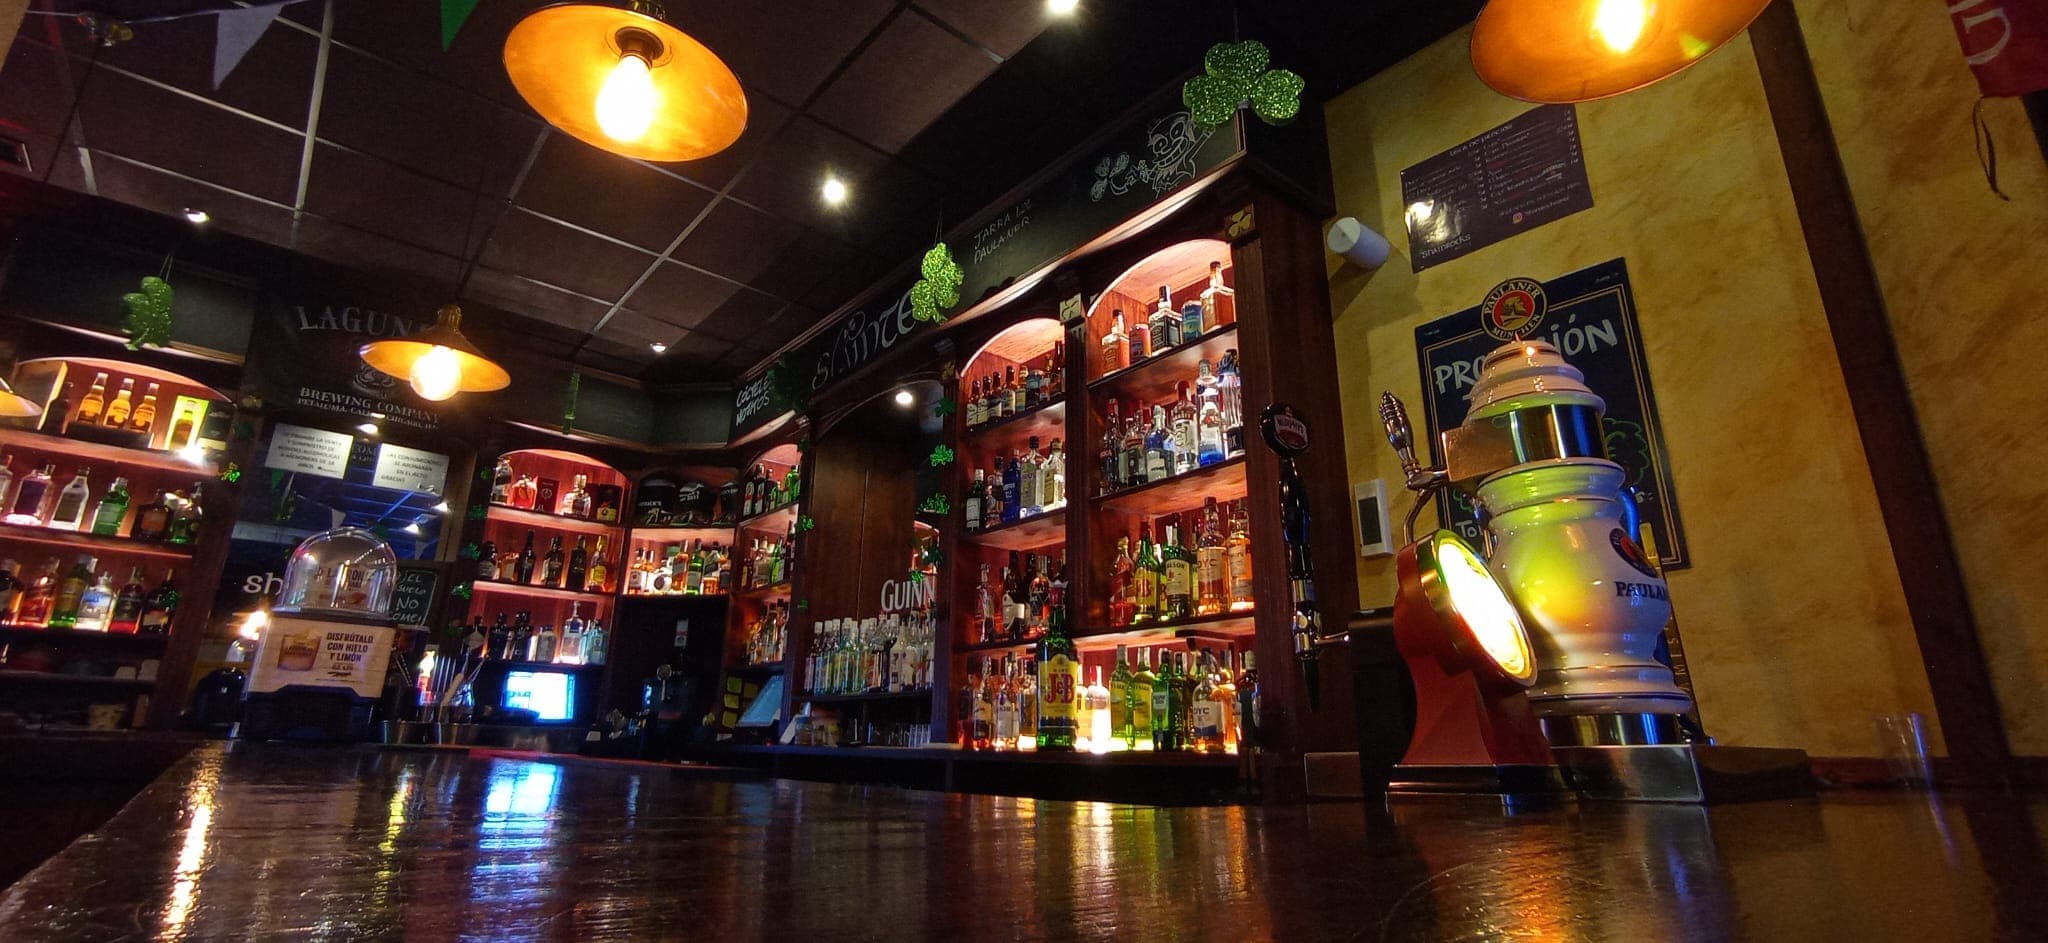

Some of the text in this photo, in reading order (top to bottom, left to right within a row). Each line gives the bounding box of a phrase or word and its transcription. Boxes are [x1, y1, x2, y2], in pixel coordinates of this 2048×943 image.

[1484, 281, 1541, 314] PAULANER
[297, 305, 413, 337] LAGUN
[300, 386, 440, 424] BREWING COMPANY
[396, 596, 419, 611] NO
[880, 576, 936, 612] GUINN
[327, 642, 369, 652] CON HIELO
[1045, 673, 1075, 705] J&B
